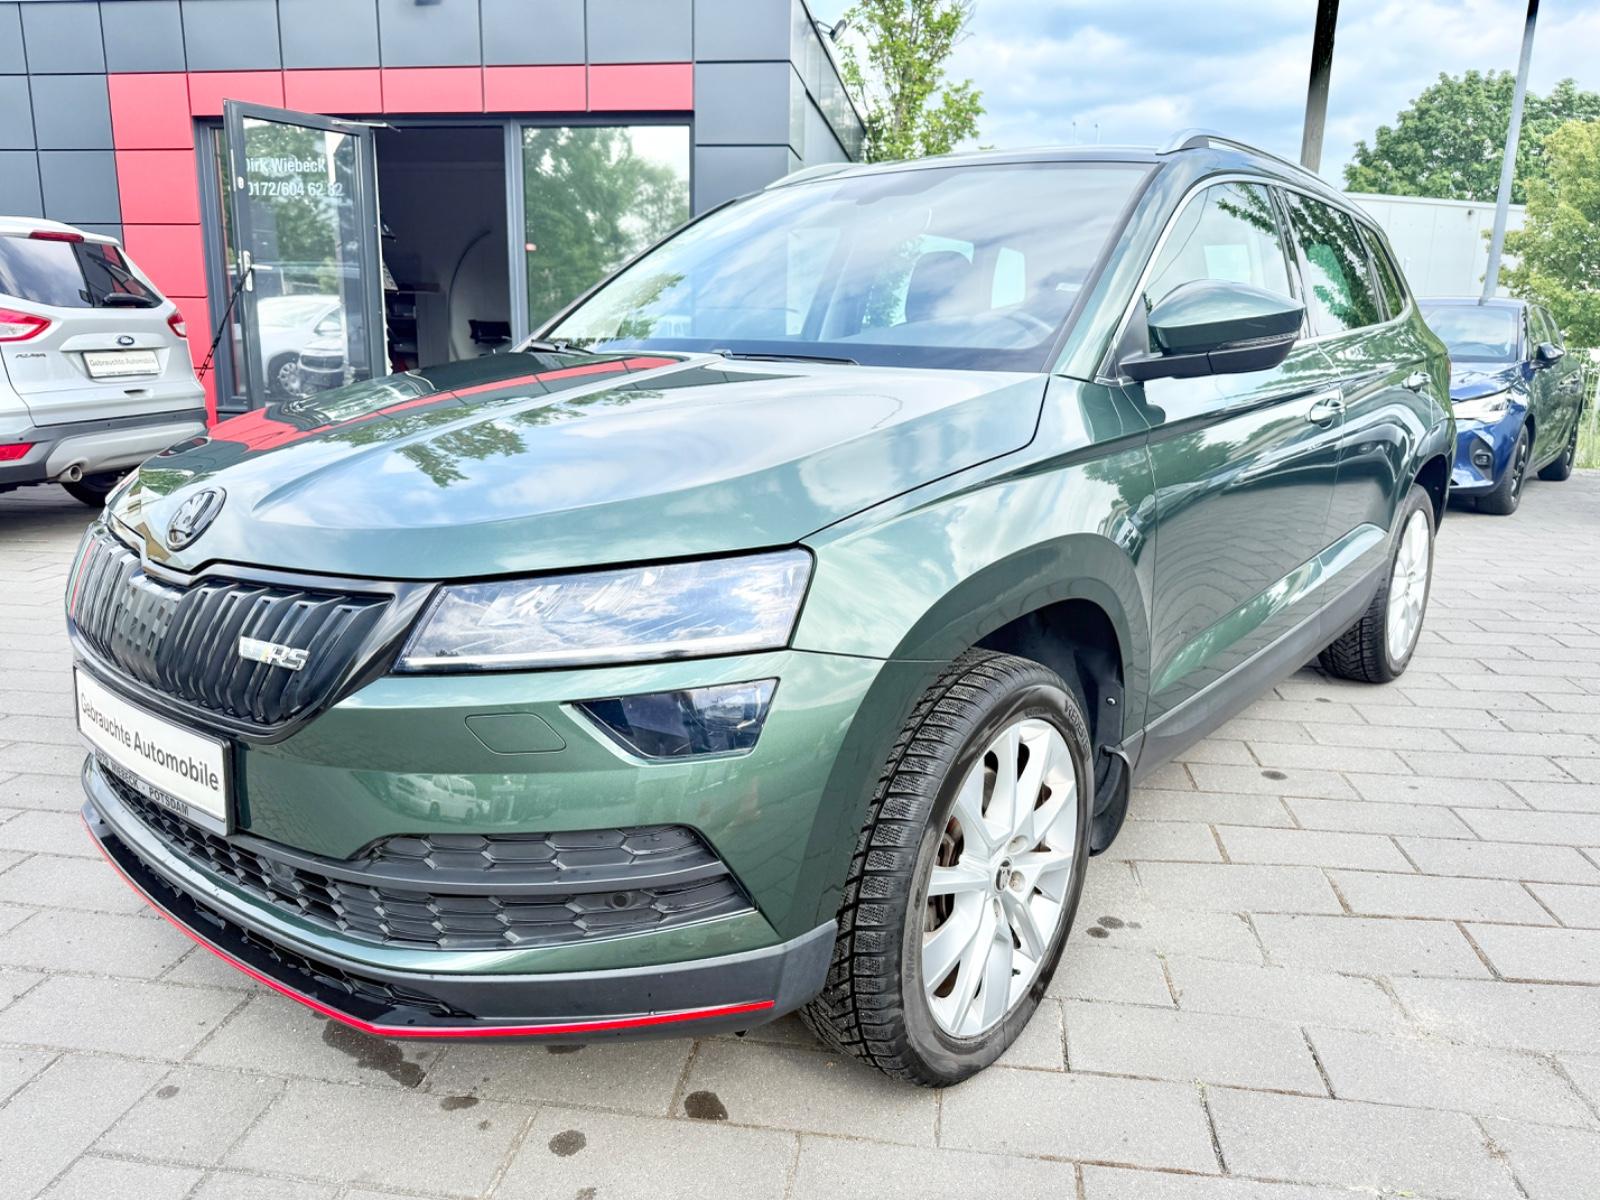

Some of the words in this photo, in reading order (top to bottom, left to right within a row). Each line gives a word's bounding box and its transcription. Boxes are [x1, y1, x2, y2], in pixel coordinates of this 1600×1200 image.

[272, 157, 326, 173] Wiebeck
[307, 182, 324, 196] 62
[327, 182, 345, 196] 82
[81, 692, 131, 748] Gebrauchte
[133, 730, 220, 791] Automobile
[149, 787, 189, 816] POTSDAM
